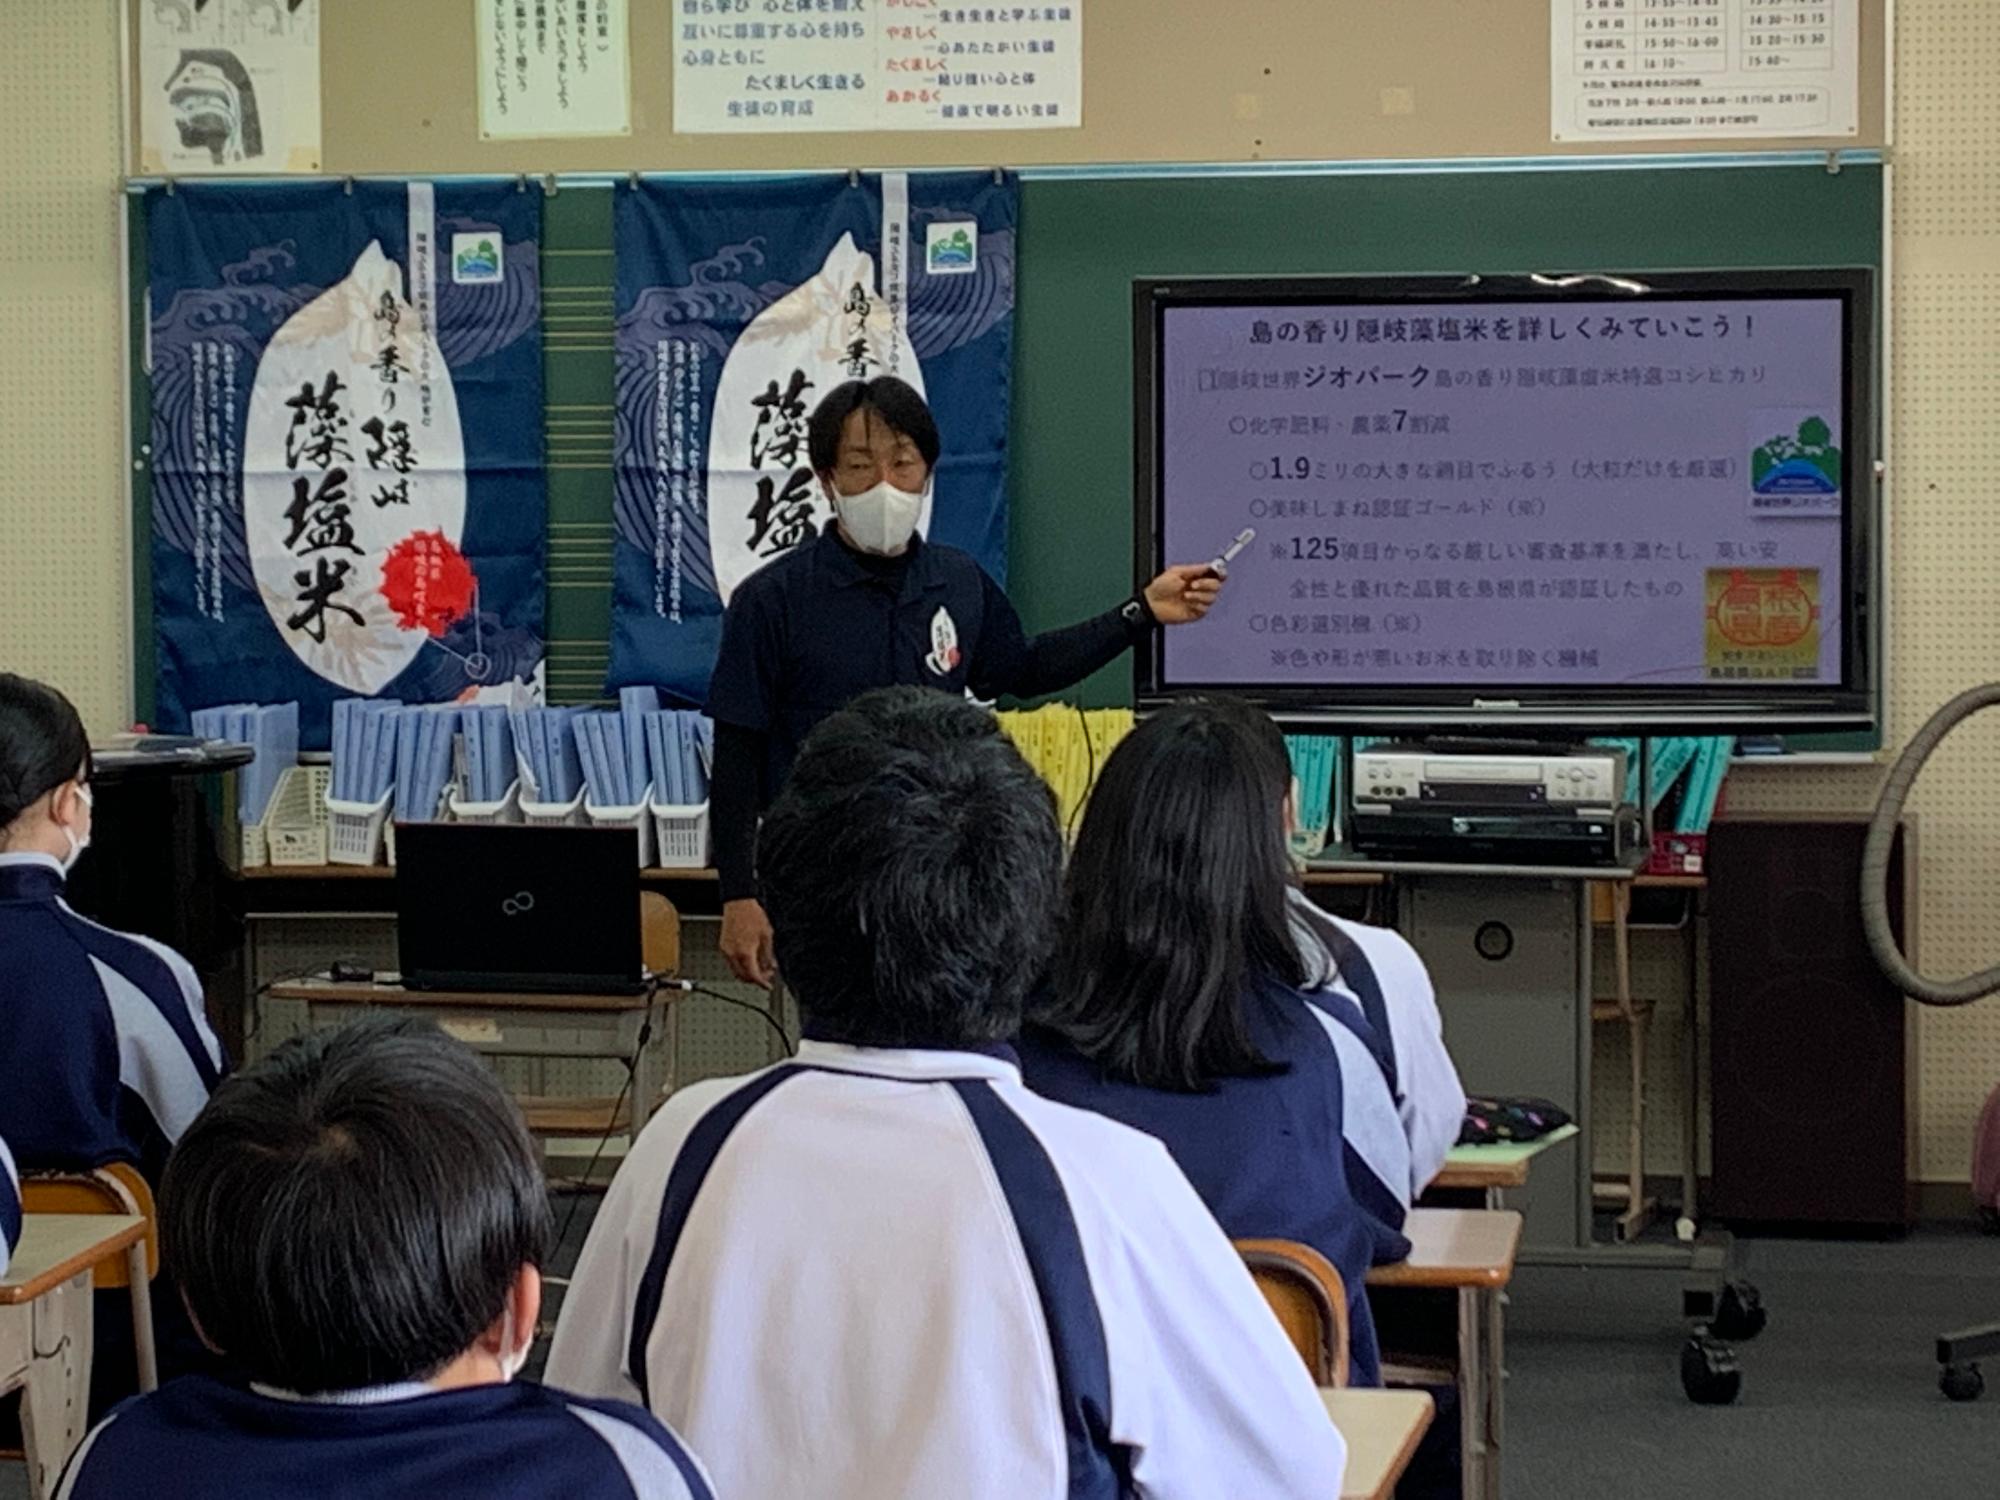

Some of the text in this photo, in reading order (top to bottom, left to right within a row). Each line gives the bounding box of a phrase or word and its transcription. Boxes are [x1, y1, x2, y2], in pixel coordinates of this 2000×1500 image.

[886, 26, 937, 39] やさしく
[683, 50, 765, 66] 心身ともに
[886, 58, 947, 71] たくましく
[745, 74, 865, 91] たくましく生きる
[886, 90, 941, 103] あかるく
[727, 99, 814, 117] 生徒の育成
[1250, 314, 1755, 344] 島の香り隠岐藻塩米を詳しくみていこう！
[284, 370, 366, 644] 藻塩米
